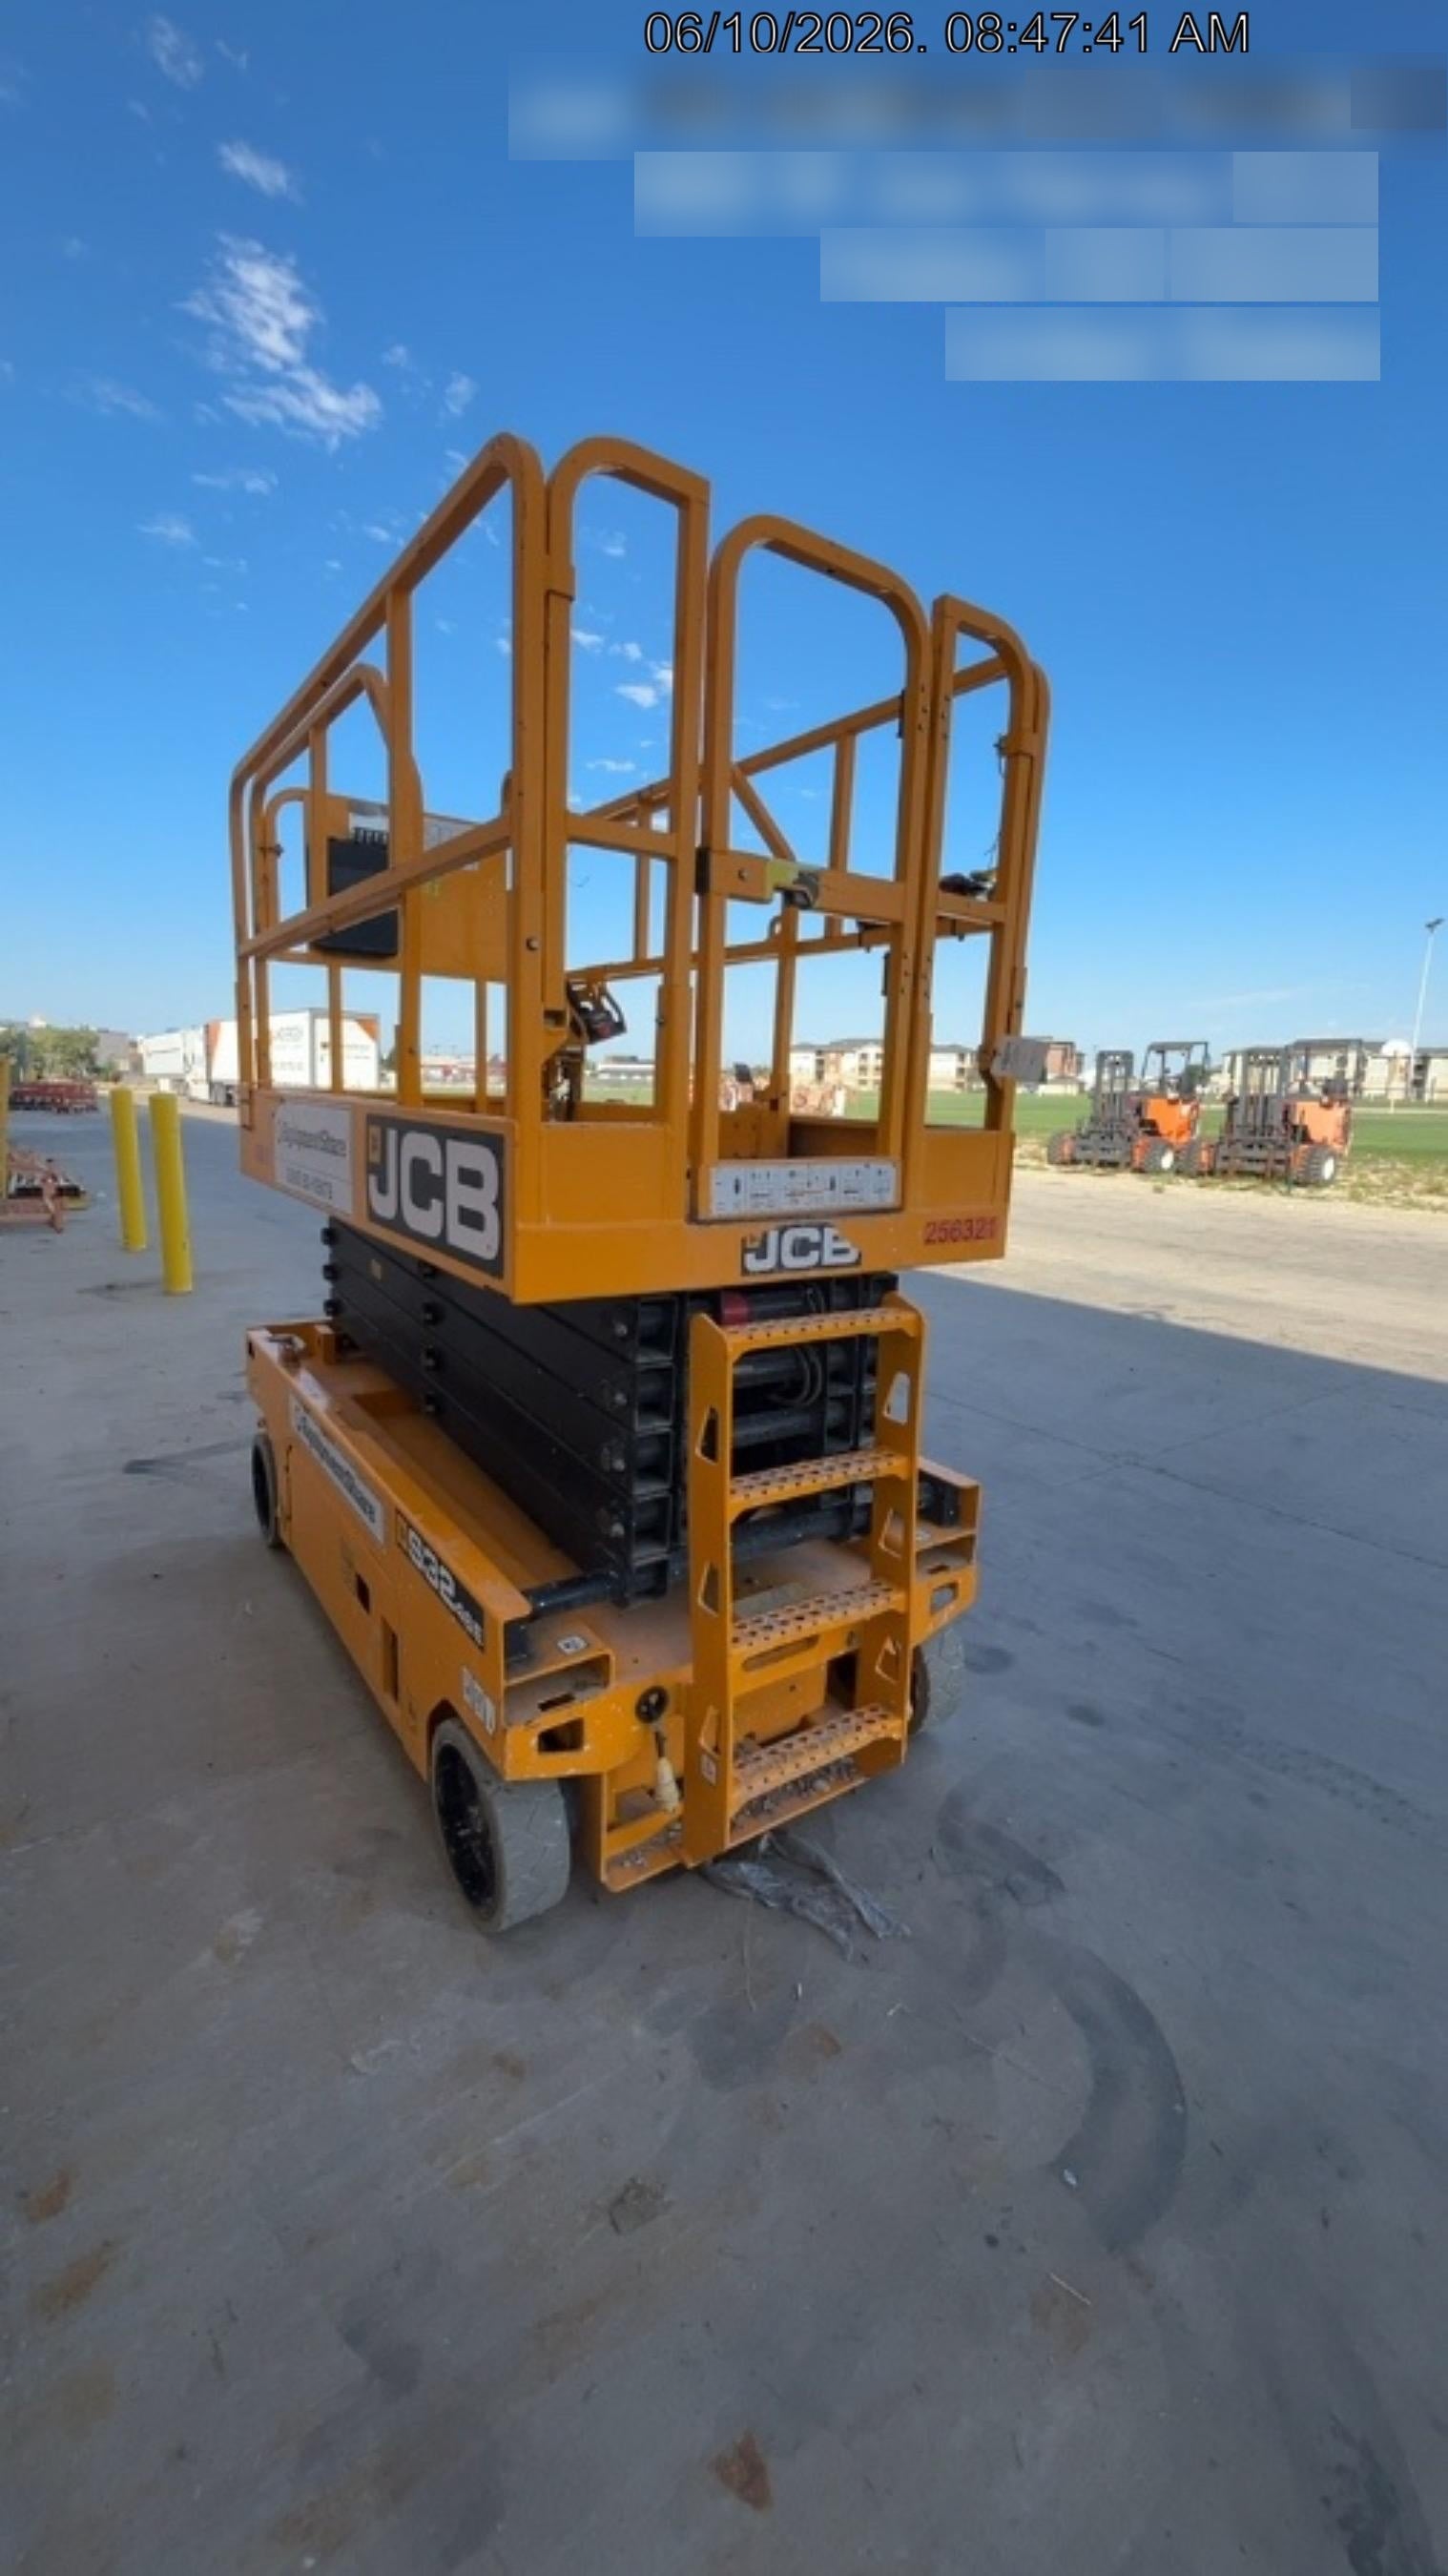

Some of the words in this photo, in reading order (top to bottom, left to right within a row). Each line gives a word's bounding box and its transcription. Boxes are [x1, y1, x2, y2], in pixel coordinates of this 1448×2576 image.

[368, 1127, 501, 1260] JCB
[743, 1227, 859, 1274] JCB
[923, 1216, 998, 1245] 256321
